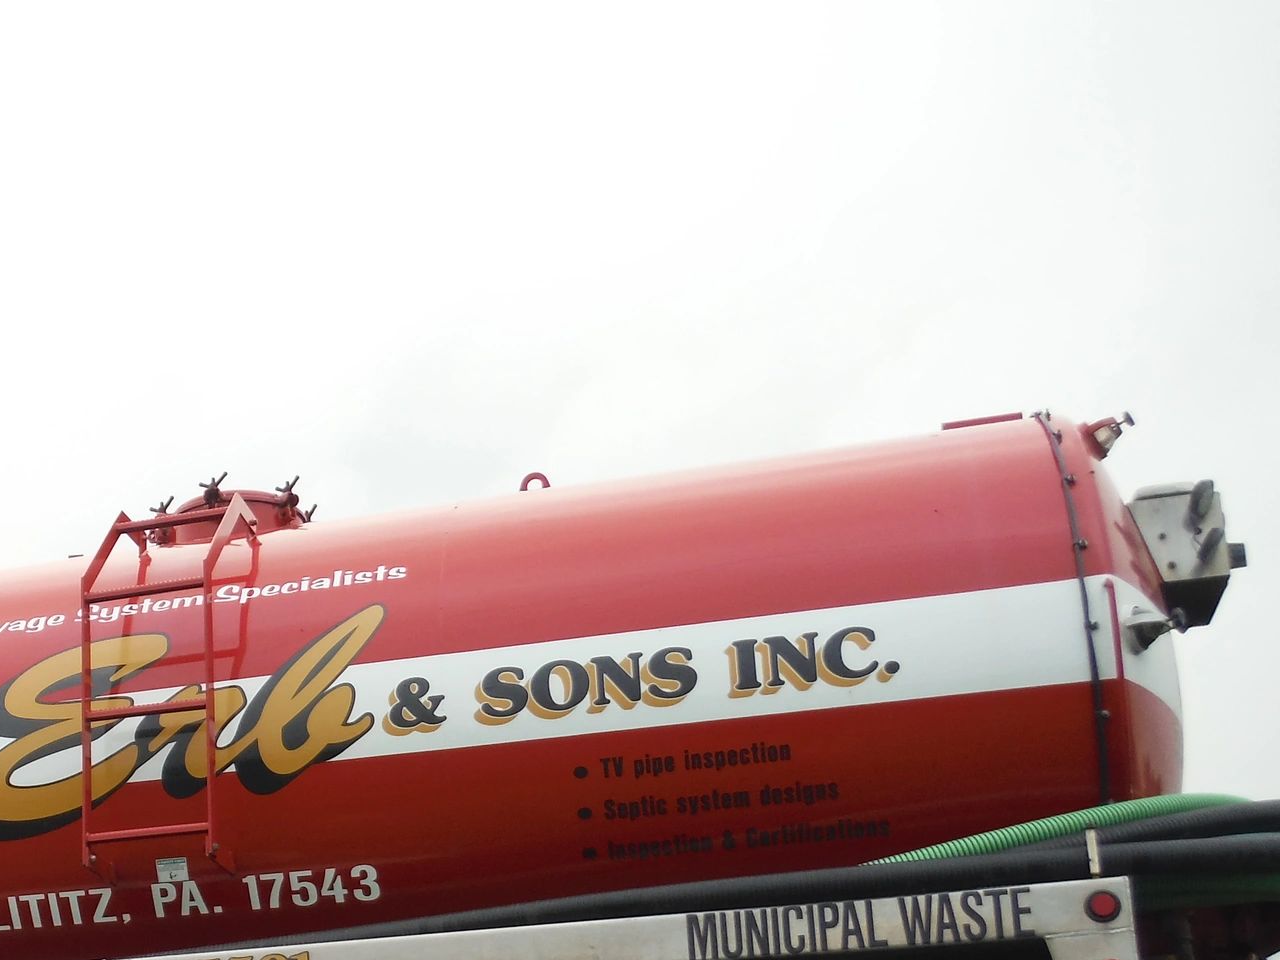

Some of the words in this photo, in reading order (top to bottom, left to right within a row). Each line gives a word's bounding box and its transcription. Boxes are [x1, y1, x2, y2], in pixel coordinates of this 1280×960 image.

[75, 592, 203, 624] System
[213, 565, 409, 604] Specialists
[382, 676, 447, 736] &
[474, 646, 698, 726] SONS
[724, 626, 901, 698] INC.
[600, 756, 624, 778] TV
[634, 753, 676, 780] pipe
[684, 742, 792, 771] inspection
[604, 796, 668, 821] Septic
[676, 788, 752, 816] system
[760, 780, 840, 805] designs
[608, 834, 713, 861] Inspection
[724, 830, 737, 851] &
[747, 817, 891, 849] Certifications
[151, 880, 223, 918] PA.
[243, 864, 382, 911] 17543
[897, 886, 1036, 945] WASTE
